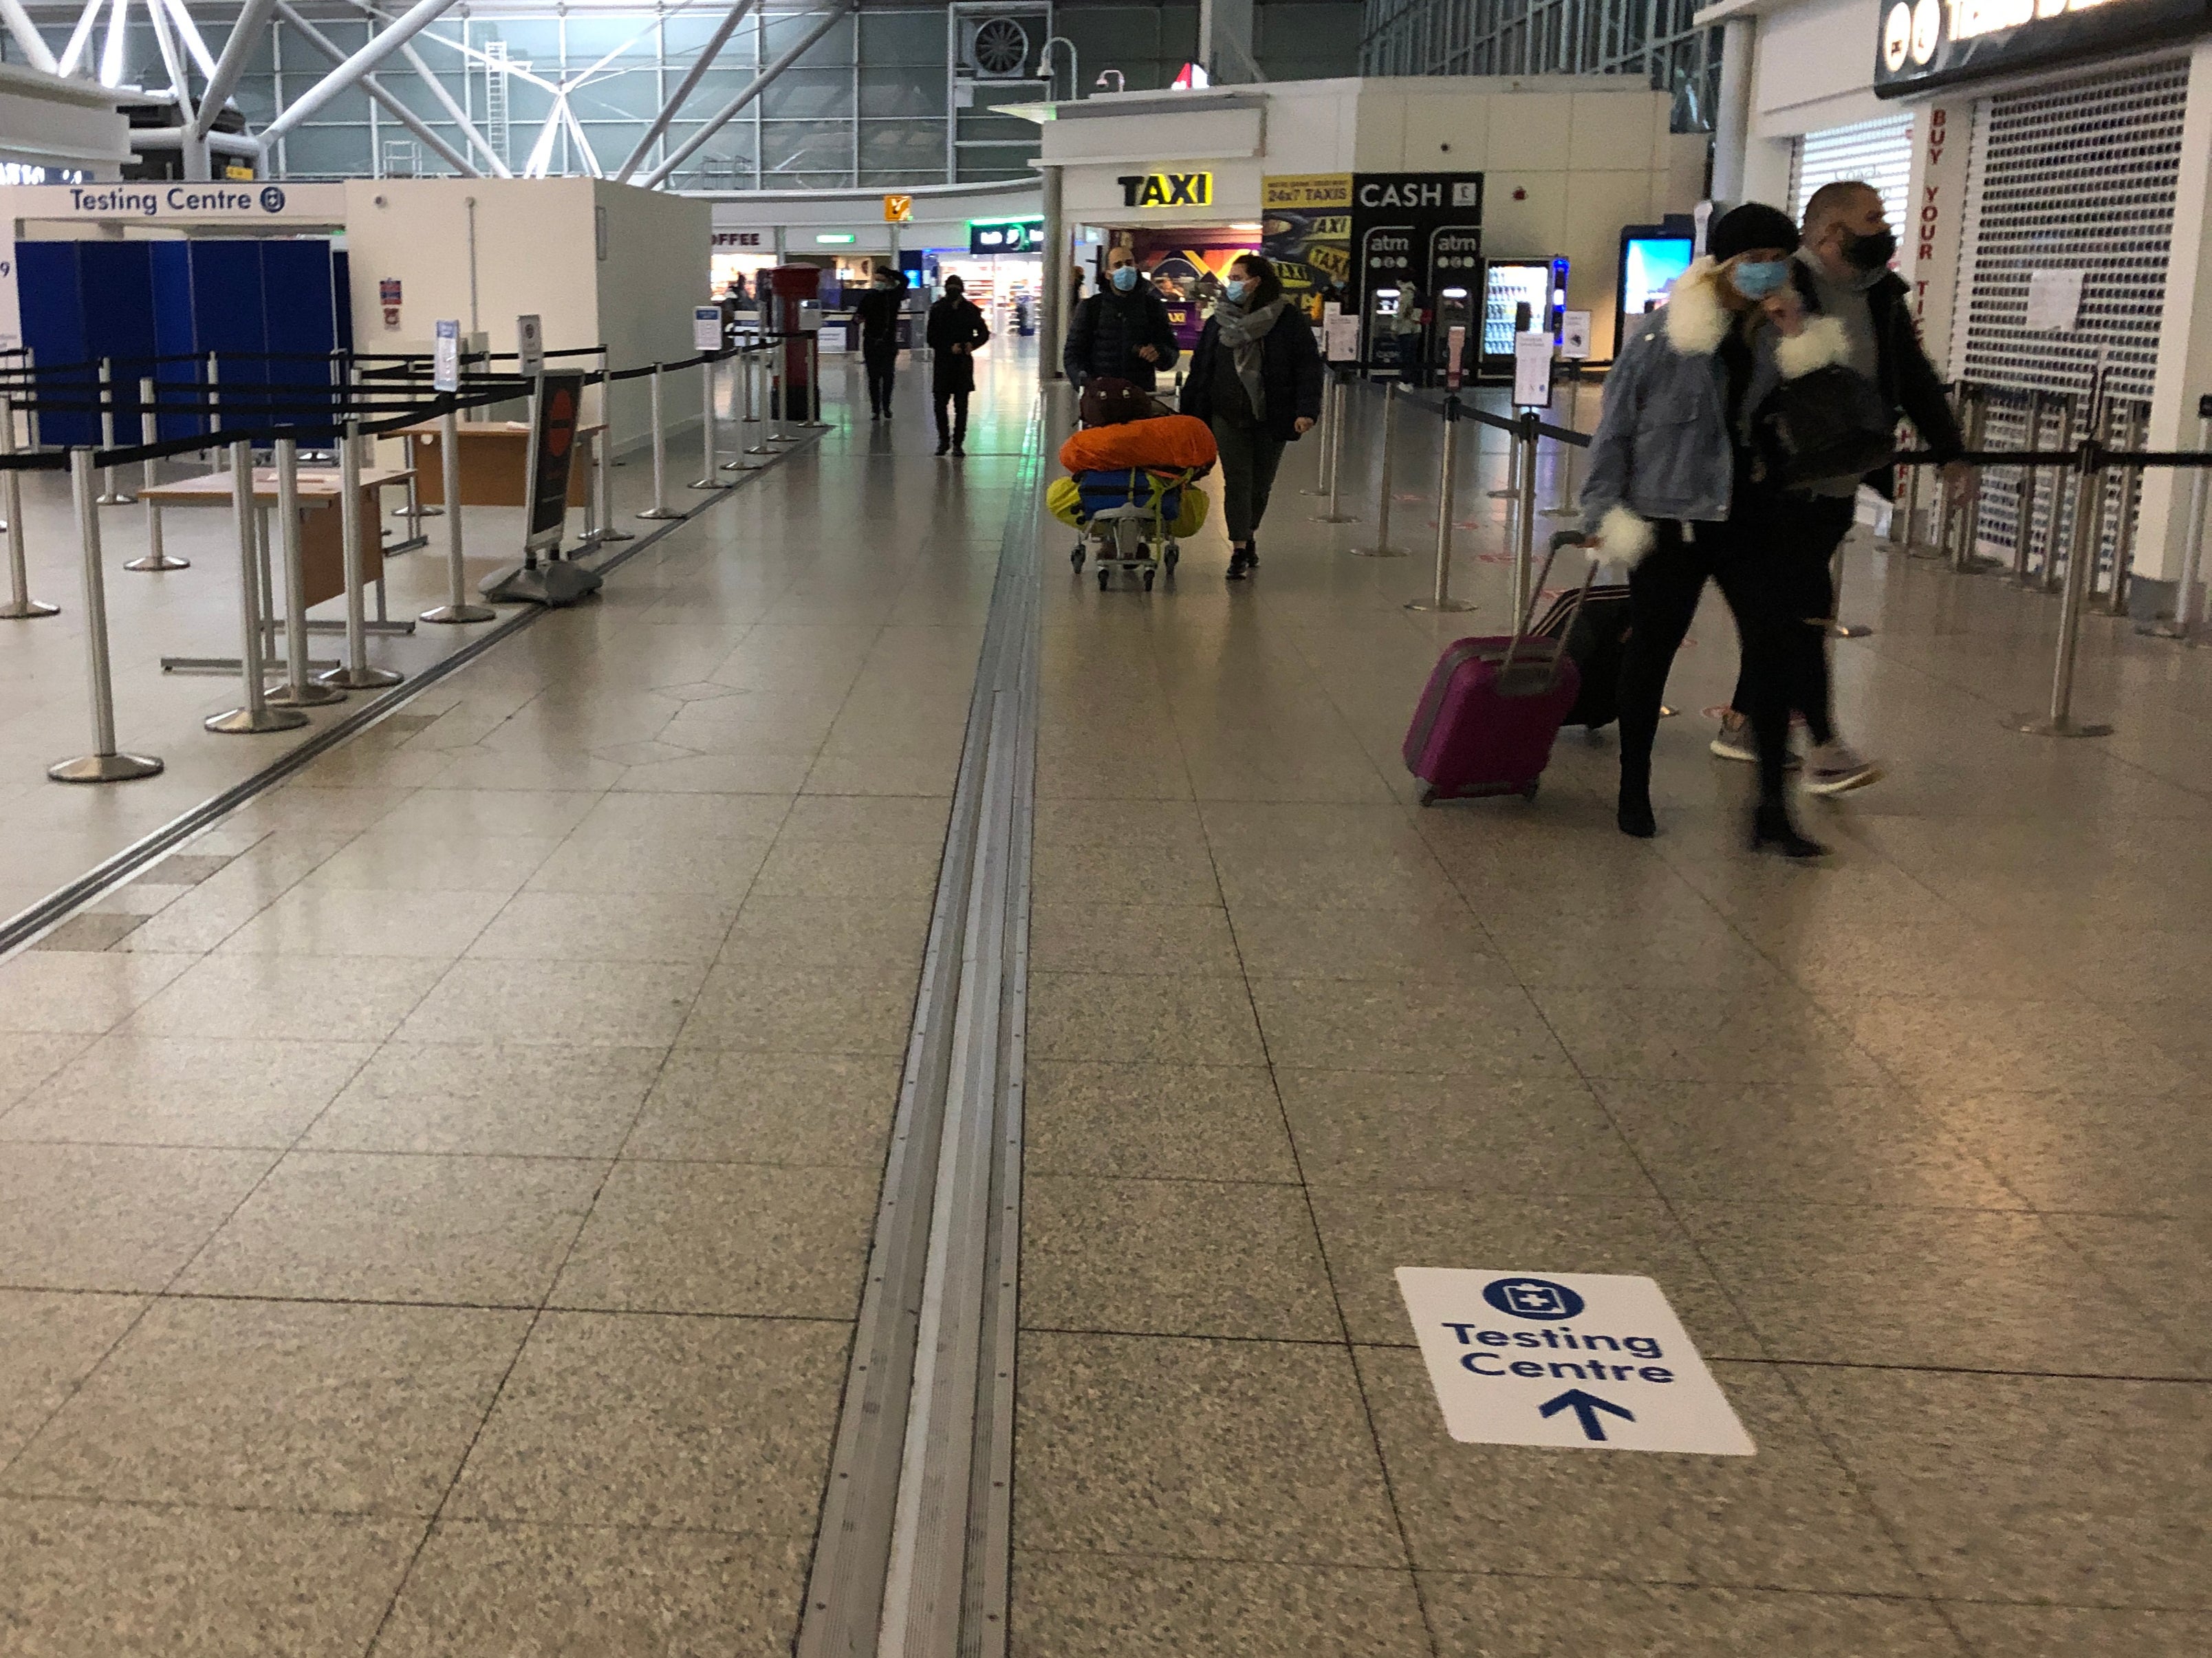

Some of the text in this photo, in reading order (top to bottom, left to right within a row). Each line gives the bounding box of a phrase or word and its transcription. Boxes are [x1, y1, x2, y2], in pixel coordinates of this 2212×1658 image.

[1930, 109, 1947, 165] BUY
[69, 187, 252, 215] Testing Centre
[1117, 172, 1213, 206] TAXI
[1305, 188, 1347, 201] TAXIS
[1360, 183, 1442, 207] CASH
[1919, 186, 1940, 260] YOUR
[1371, 235, 1409, 251] atm
[1438, 234, 1476, 251] atm
[1442, 1322, 1663, 1359] Testing
[1460, 1352, 1675, 1384] Centre
